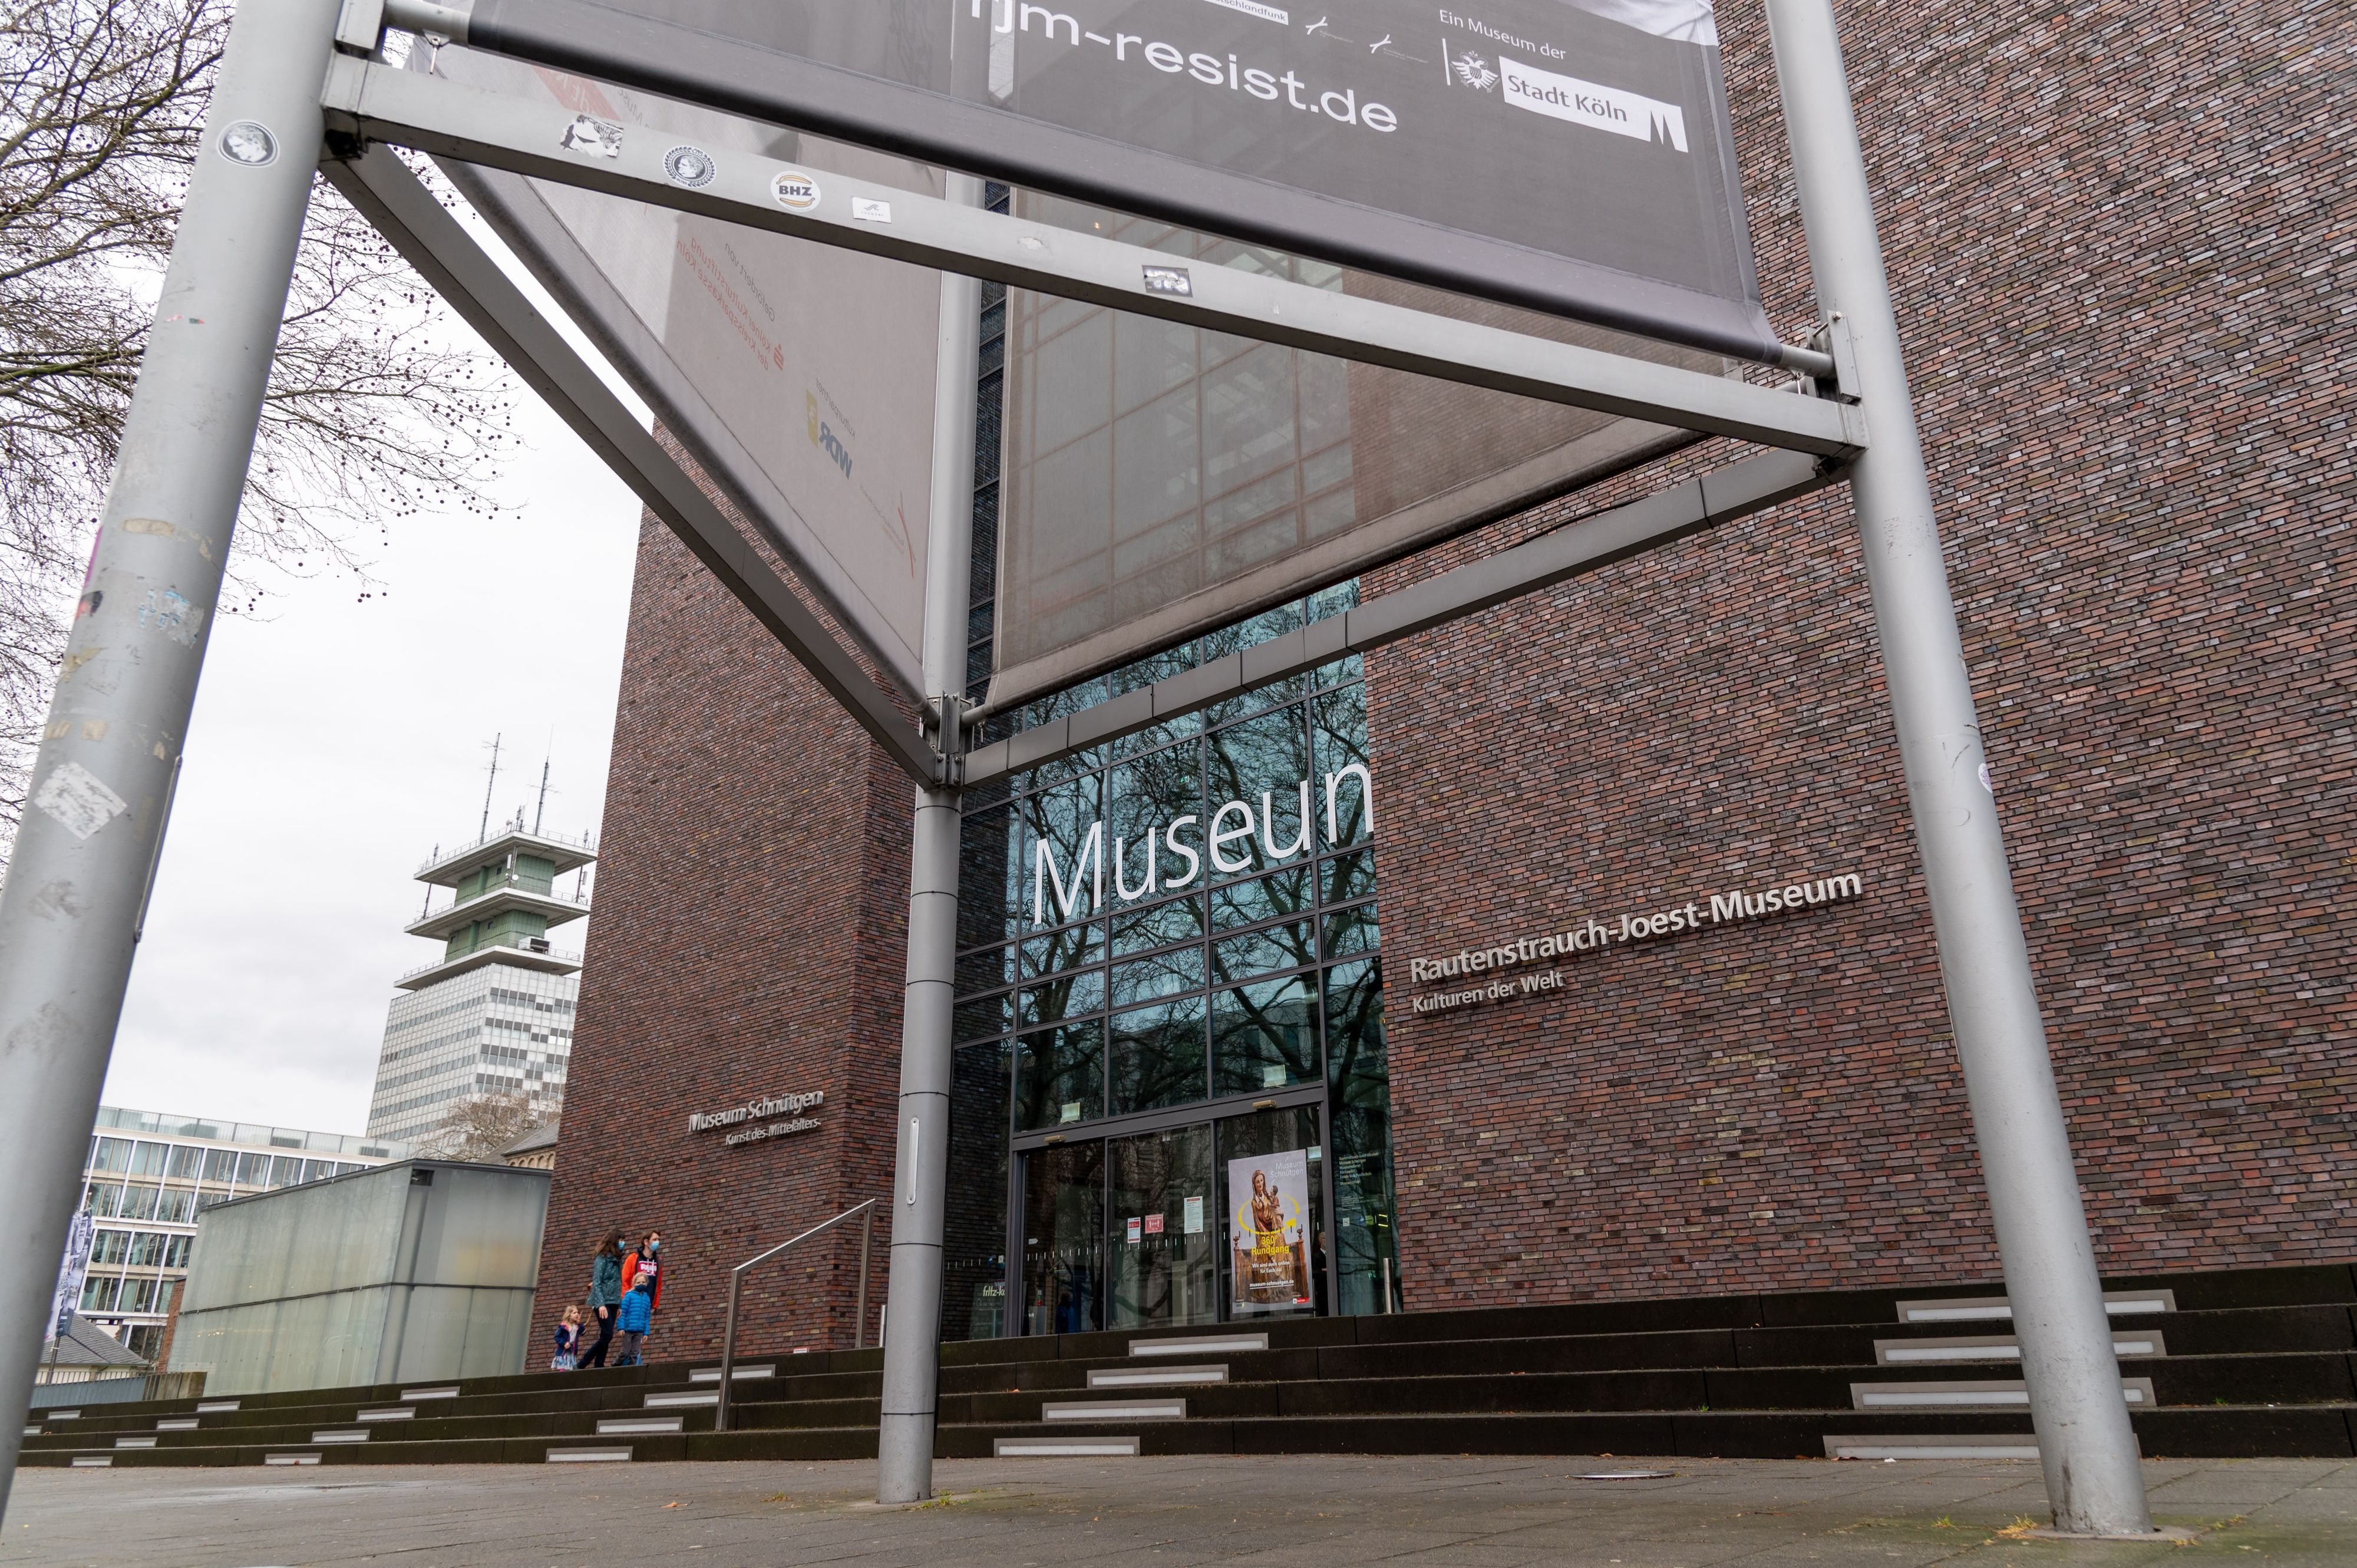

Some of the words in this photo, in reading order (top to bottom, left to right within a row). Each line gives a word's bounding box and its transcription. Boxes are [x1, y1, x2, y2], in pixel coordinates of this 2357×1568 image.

[1439, 9, 1464, 29] Ein
[1468, 18, 1536, 52] Museum
[1540, 42, 1566, 60] der
[1507, 74, 1570, 108] Stadt
[1575, 93, 1628, 122] Köln
[778, 185, 812, 197] BHZ
[1411, 873, 1863, 983] Rautenstrauch-Joest-Museum
[1412, 988, 1483, 1014] Kulturen
[1487, 979, 1516, 1000] der
[1519, 970, 1564, 993] Welt
[688, 1107, 747, 1132] Museum
[748, 1090, 824, 1120] Schnütgen
[725, 1130, 751, 1146] Kunst
[751, 1127, 766, 1140] des
[768, 1118, 818, 1137] Mittelalters
[1270, 1168, 1303, 1179] Schnütgen
[1275, 1160, 1303, 1170] Museum
[1261, 1235, 1278, 1245] 360°
[1251, 1245, 1290, 1256] Rundgang
[1249, 1279, 1294, 1288] museum-schnuetgen.de
